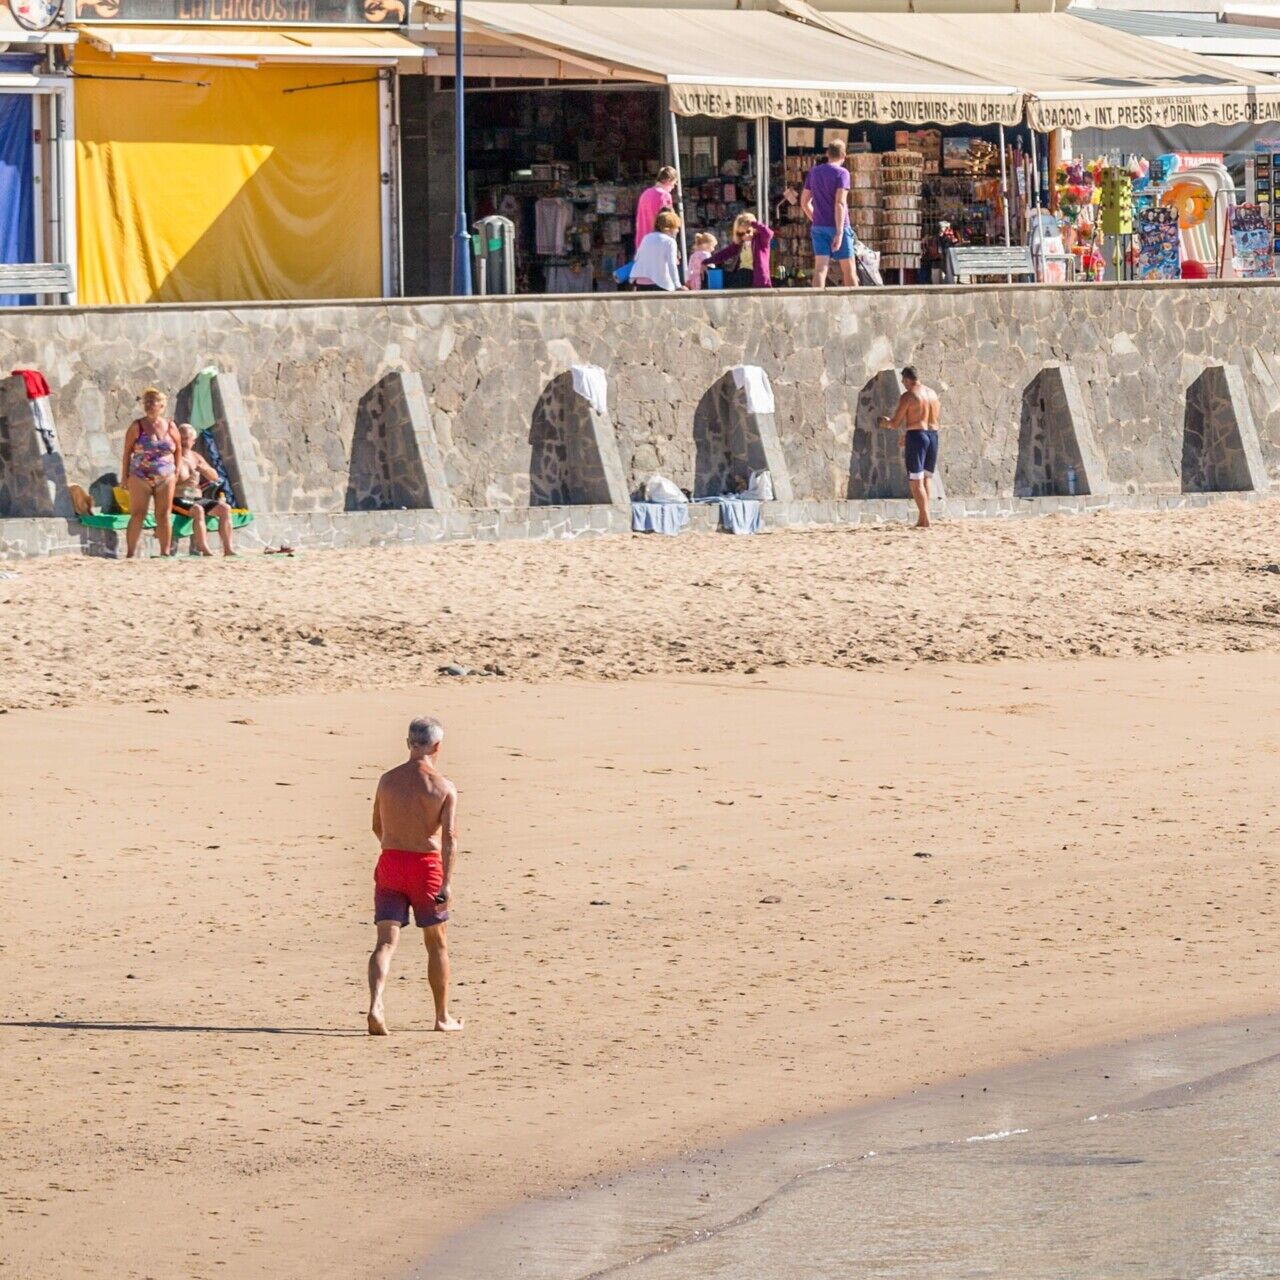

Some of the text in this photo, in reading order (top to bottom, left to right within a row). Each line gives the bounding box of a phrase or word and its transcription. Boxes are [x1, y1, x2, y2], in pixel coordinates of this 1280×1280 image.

[680, 93, 1017, 122] LOTHES BIKINIS BAGS ALOE VERA SOUVENIRS SUN CREAM
[1094, 106, 1116, 126] INT.
[1117, 105, 1153, 124] PRESS
[1170, 103, 1209, 123] DRINKS
